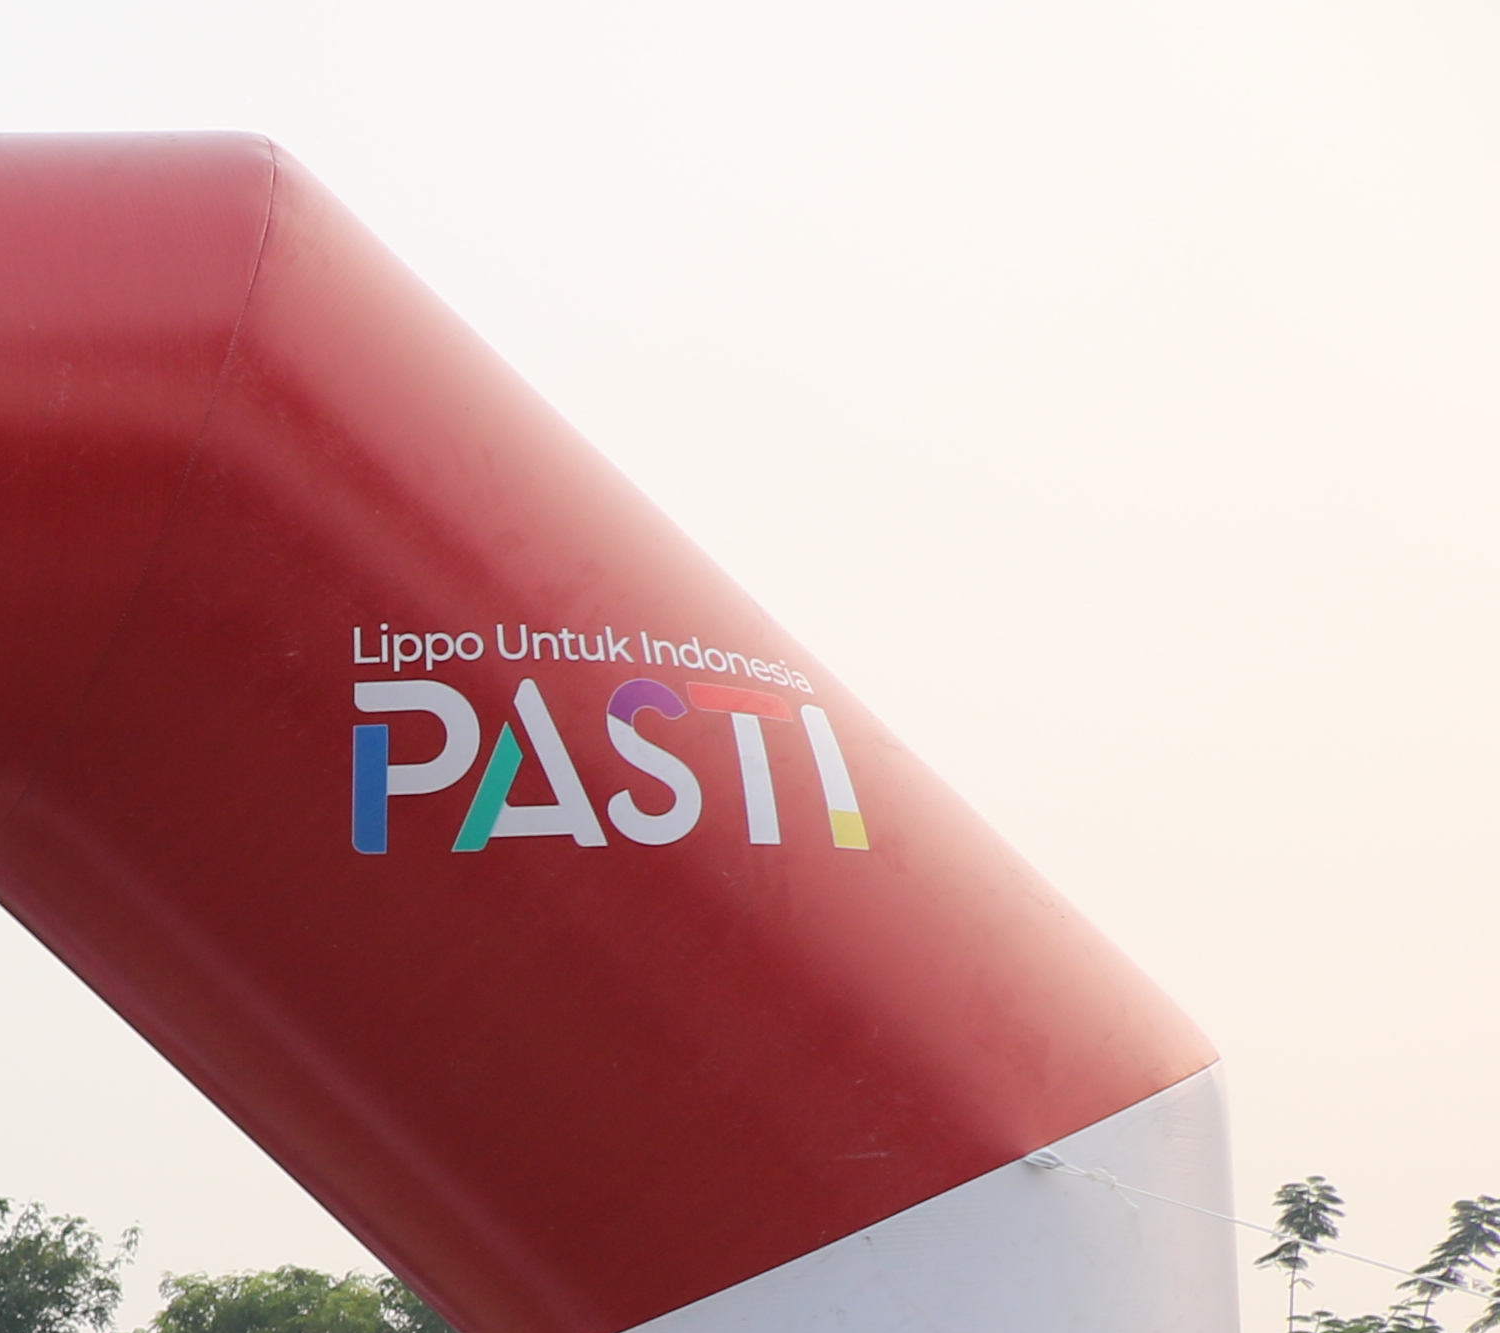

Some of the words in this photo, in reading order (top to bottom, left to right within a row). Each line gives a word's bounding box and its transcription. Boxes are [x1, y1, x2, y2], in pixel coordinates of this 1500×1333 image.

[352, 623, 485, 672] Lippo
[495, 623, 634, 664] Untuk
[640, 631, 814, 695] Indonesia
[351, 677, 871, 854] PASTI
